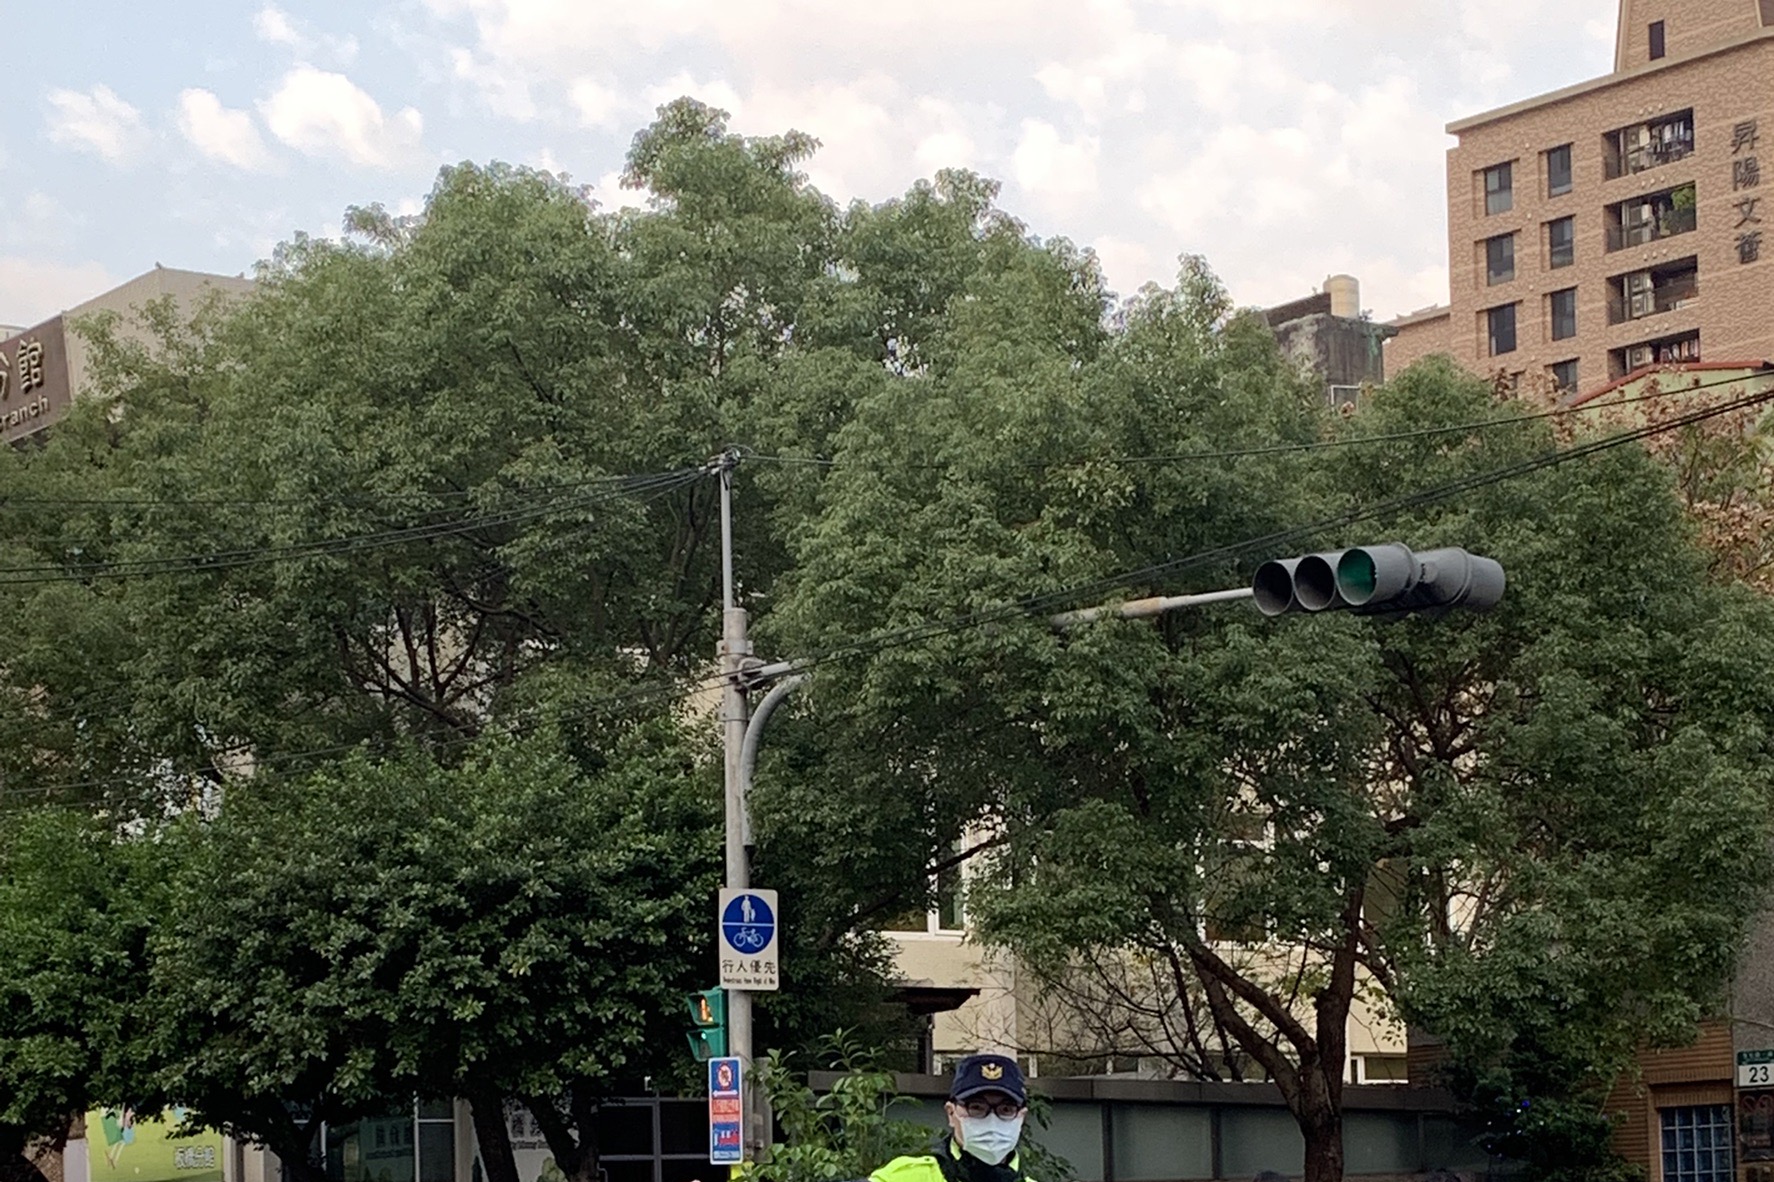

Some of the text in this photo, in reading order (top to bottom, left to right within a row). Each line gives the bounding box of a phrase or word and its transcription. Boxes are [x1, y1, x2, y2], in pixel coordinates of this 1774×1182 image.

[0, 395, 50, 433] ranch
[722, 959, 776, 975] 行人優先
[1748, 1065, 1770, 1083] 23
